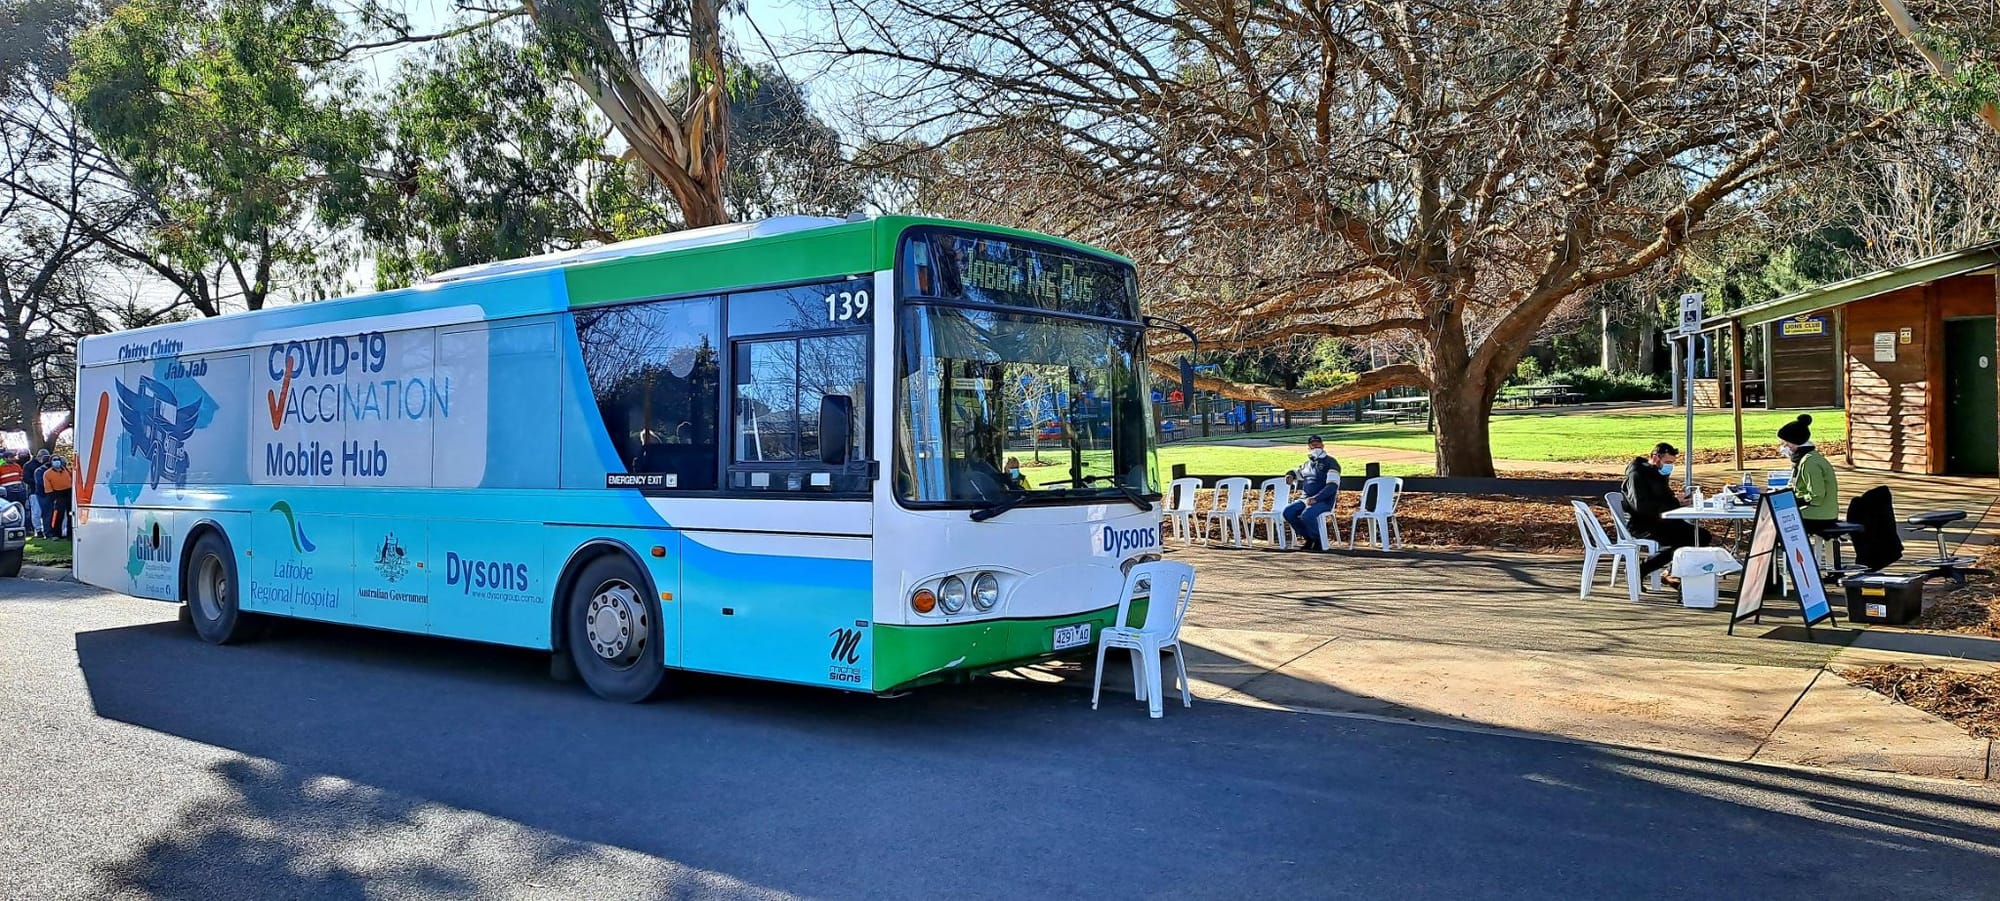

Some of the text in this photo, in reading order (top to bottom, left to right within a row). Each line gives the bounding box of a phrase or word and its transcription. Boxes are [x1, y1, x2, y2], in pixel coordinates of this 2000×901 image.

[825, 290, 869, 321] 139
[1686, 297, 1695, 308] P
[118, 338, 184, 363] Chitty Chitty
[268, 331, 387, 381] COVID-19
[164, 358, 208, 380] Jab Jab
[266, 440, 388, 477] Mobile Hub
[608, 475, 663, 485] EMERGENCY EXIT
[1103, 526, 1155, 558] Dysons
[274, 560, 313, 580] Latrobe
[446, 551, 529, 595] Dysons
[251, 581, 340, 610] Regional Hospital
[359, 587, 429, 604] Australian Government
[1056, 631, 1075, 644] 4291
